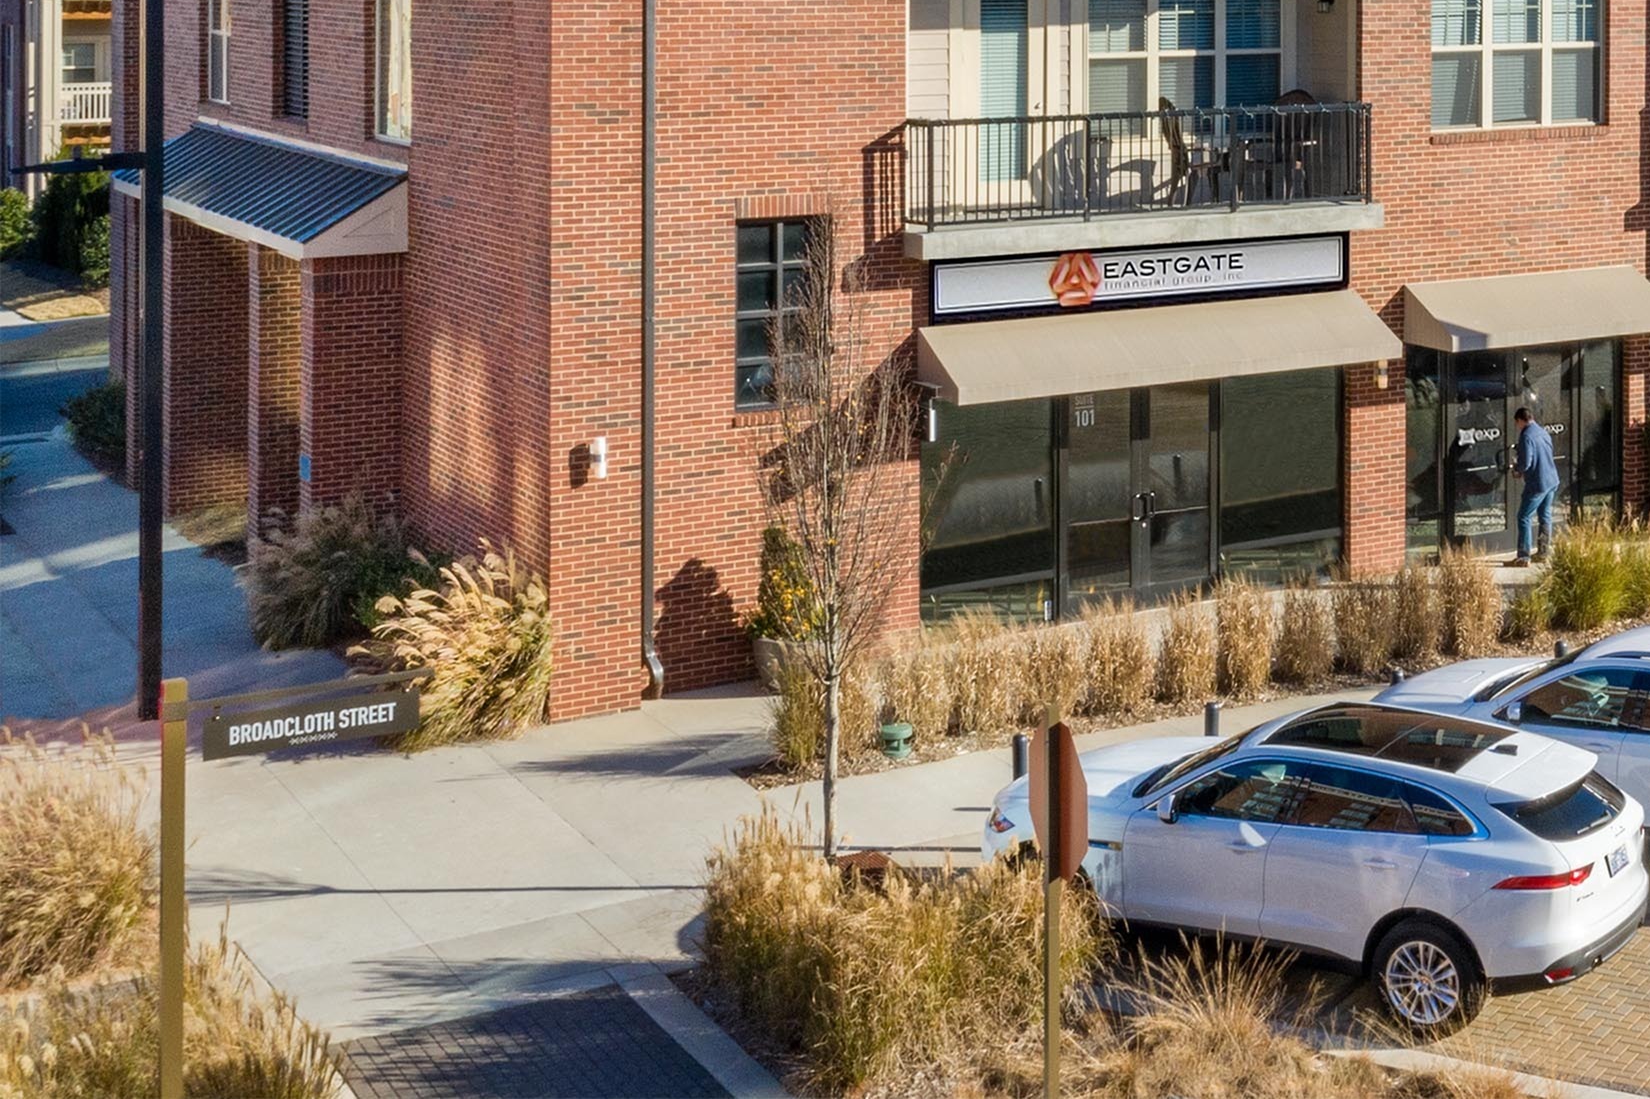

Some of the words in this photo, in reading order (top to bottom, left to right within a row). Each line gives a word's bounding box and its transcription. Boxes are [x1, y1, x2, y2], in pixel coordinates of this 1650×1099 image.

[1103, 253, 1244, 279] EASTGATE
[1104, 278, 1166, 291] financial
[1075, 409, 1095, 427] 101
[1475, 427, 1500, 441] exp
[229, 711, 335, 746] BROADCLOTH
[338, 702, 397, 729] STREET
